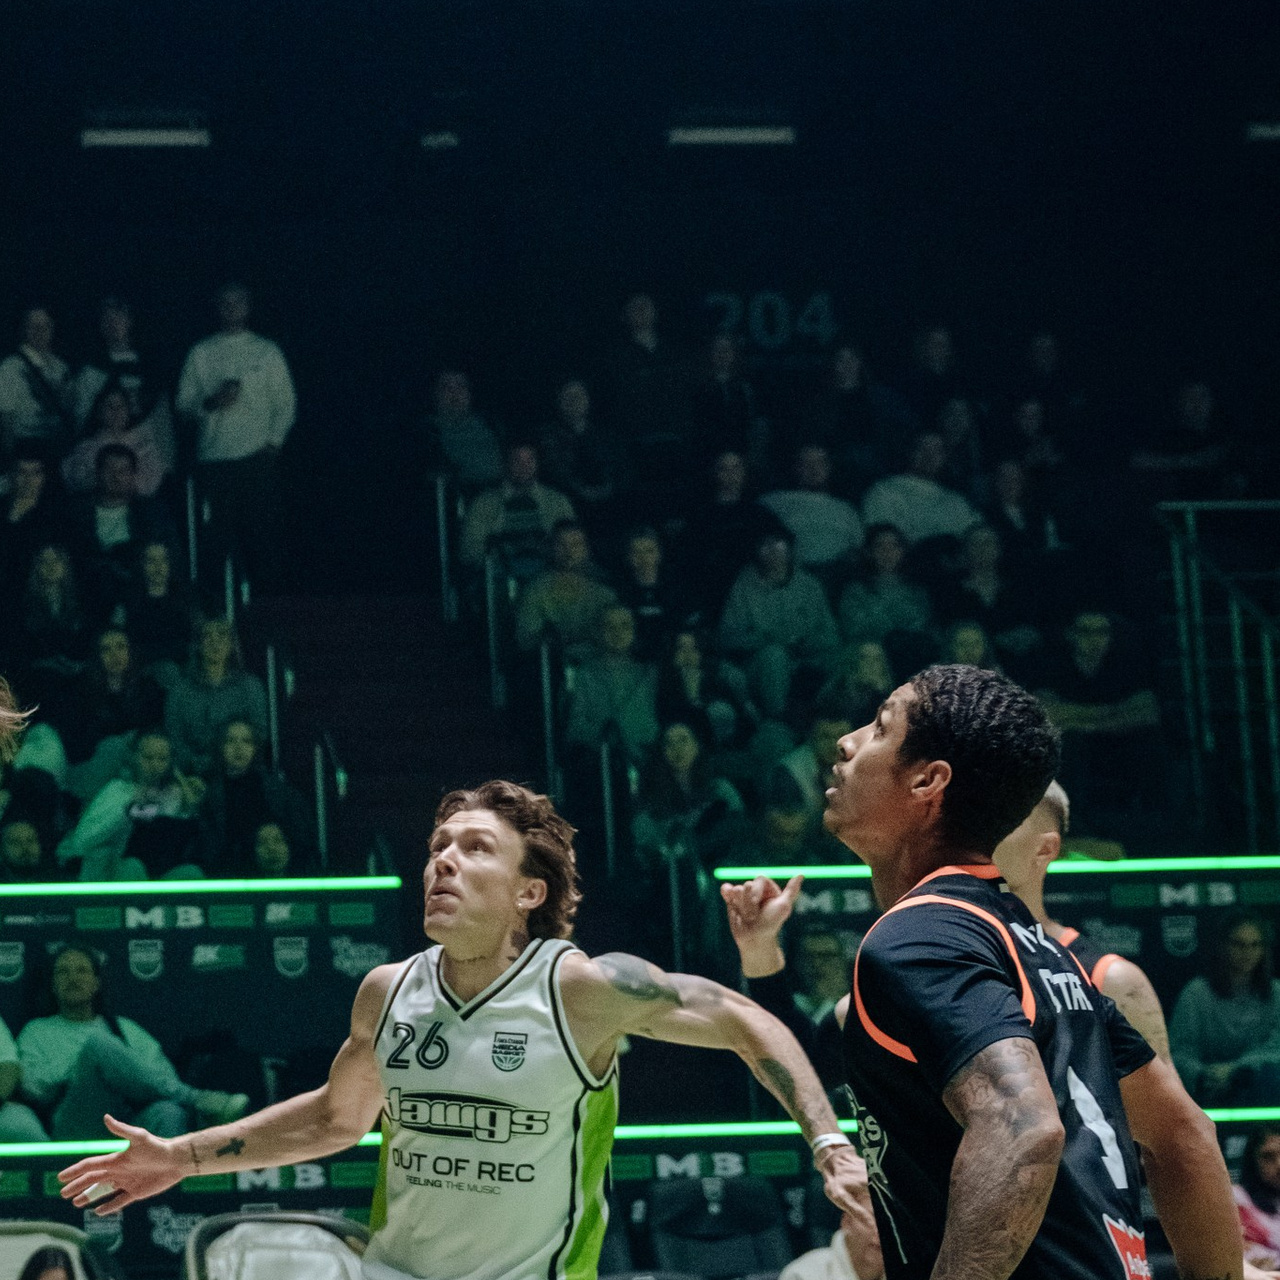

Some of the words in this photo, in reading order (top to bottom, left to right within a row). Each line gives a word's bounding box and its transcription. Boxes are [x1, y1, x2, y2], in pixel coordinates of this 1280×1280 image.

[385, 1020, 450, 1070] 26
[392, 1147, 427, 1172] OUT
[432, 1155, 470, 1177] OF
[477, 1160, 536, 1183] REC
[406, 1174, 443, 1188] FEELING
[445, 1177, 466, 1191] THE
[467, 1181, 502, 1195] MUSIC
